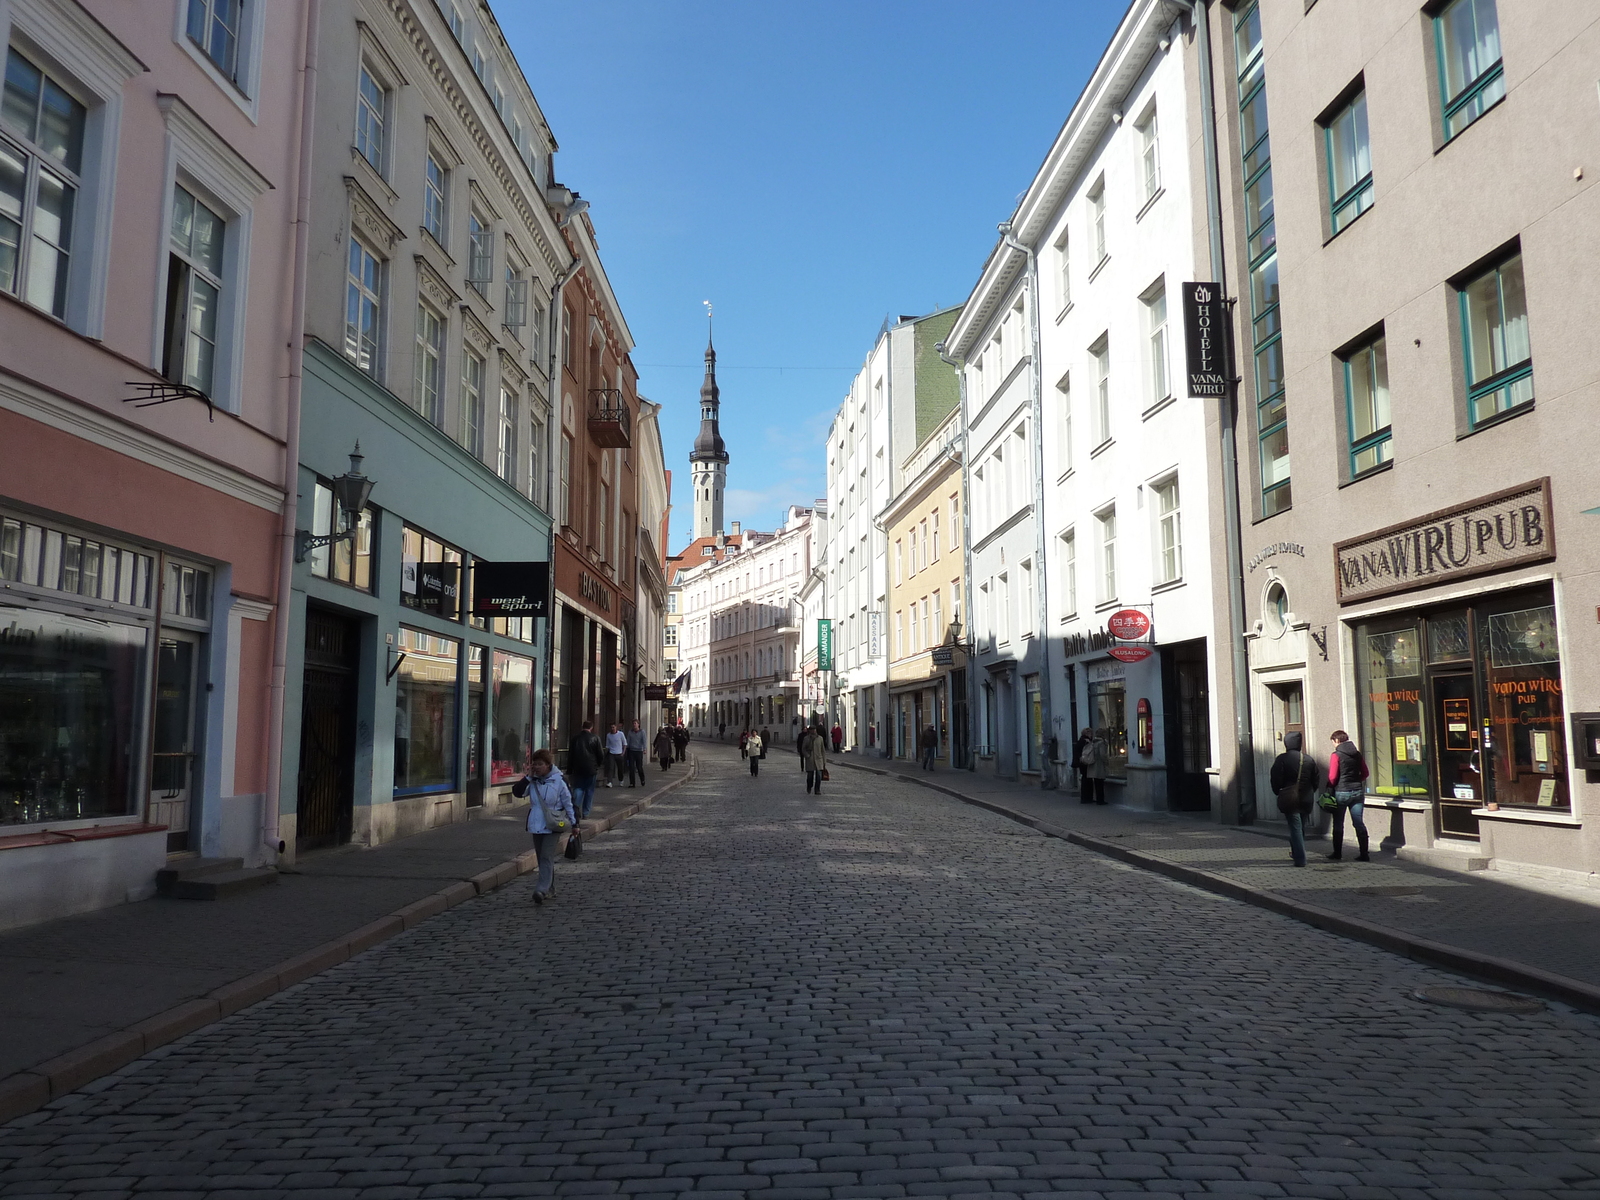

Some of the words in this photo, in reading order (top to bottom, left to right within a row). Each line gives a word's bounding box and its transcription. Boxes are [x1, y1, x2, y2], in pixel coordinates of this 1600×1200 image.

[1198, 305, 1212, 372] HOTELL
[1191, 374, 1224, 384] VANA
[1192, 384, 1225, 395] WIRU
[1340, 548, 1391, 589] VANA
[1387, 516, 1474, 580] WIRU
[1473, 505, 1545, 556] PUB
[491, 595, 527, 604] west
[582, 571, 613, 613] BASTION
[501, 601, 543, 612] sport
[1063, 632, 1086, 658] Baltic
